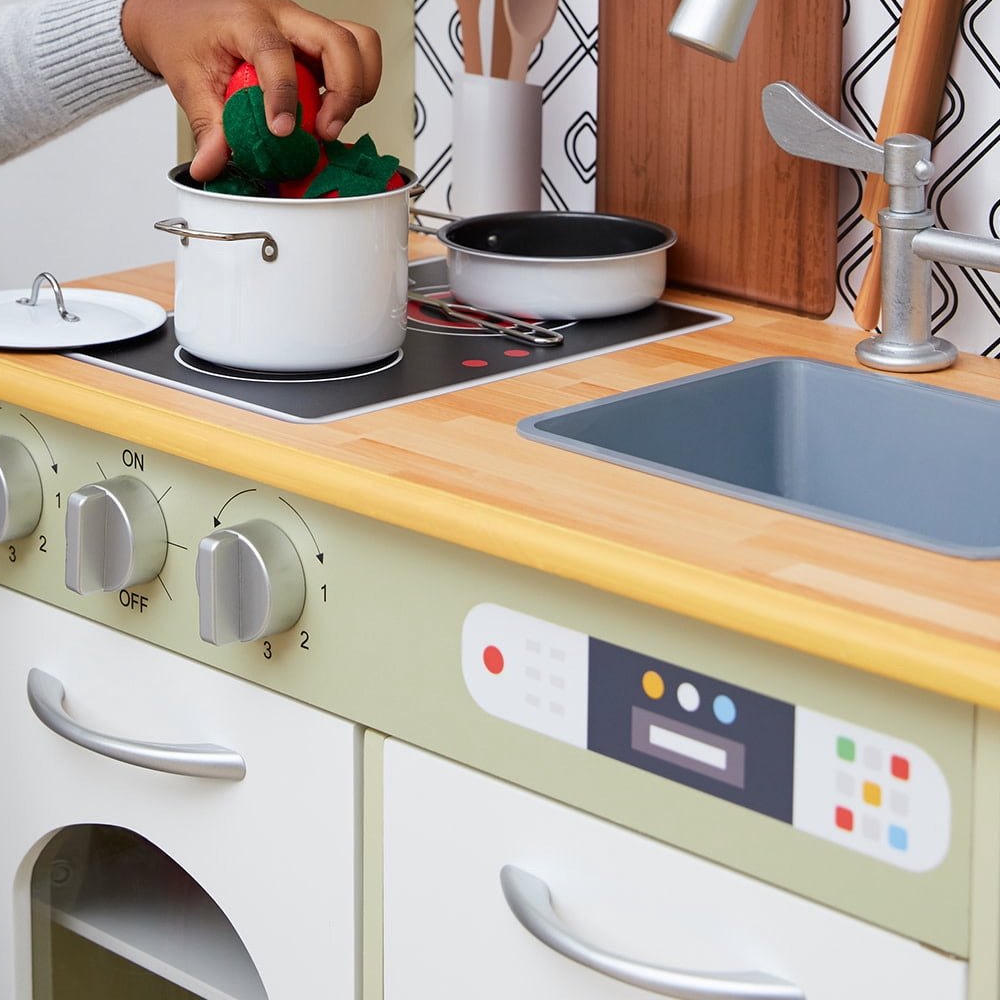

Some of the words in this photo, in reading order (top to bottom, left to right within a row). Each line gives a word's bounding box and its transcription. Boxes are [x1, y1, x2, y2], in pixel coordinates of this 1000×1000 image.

[122, 449, 145, 472] ON
[55, 493, 62, 509] 1
[39, 535, 48, 553] 2
[9, 546, 17, 563] 3
[119, 589, 149, 614] OFF
[320, 584, 328, 602] 1
[300, 631, 310, 650] 2
[263, 641, 273, 660] 3
